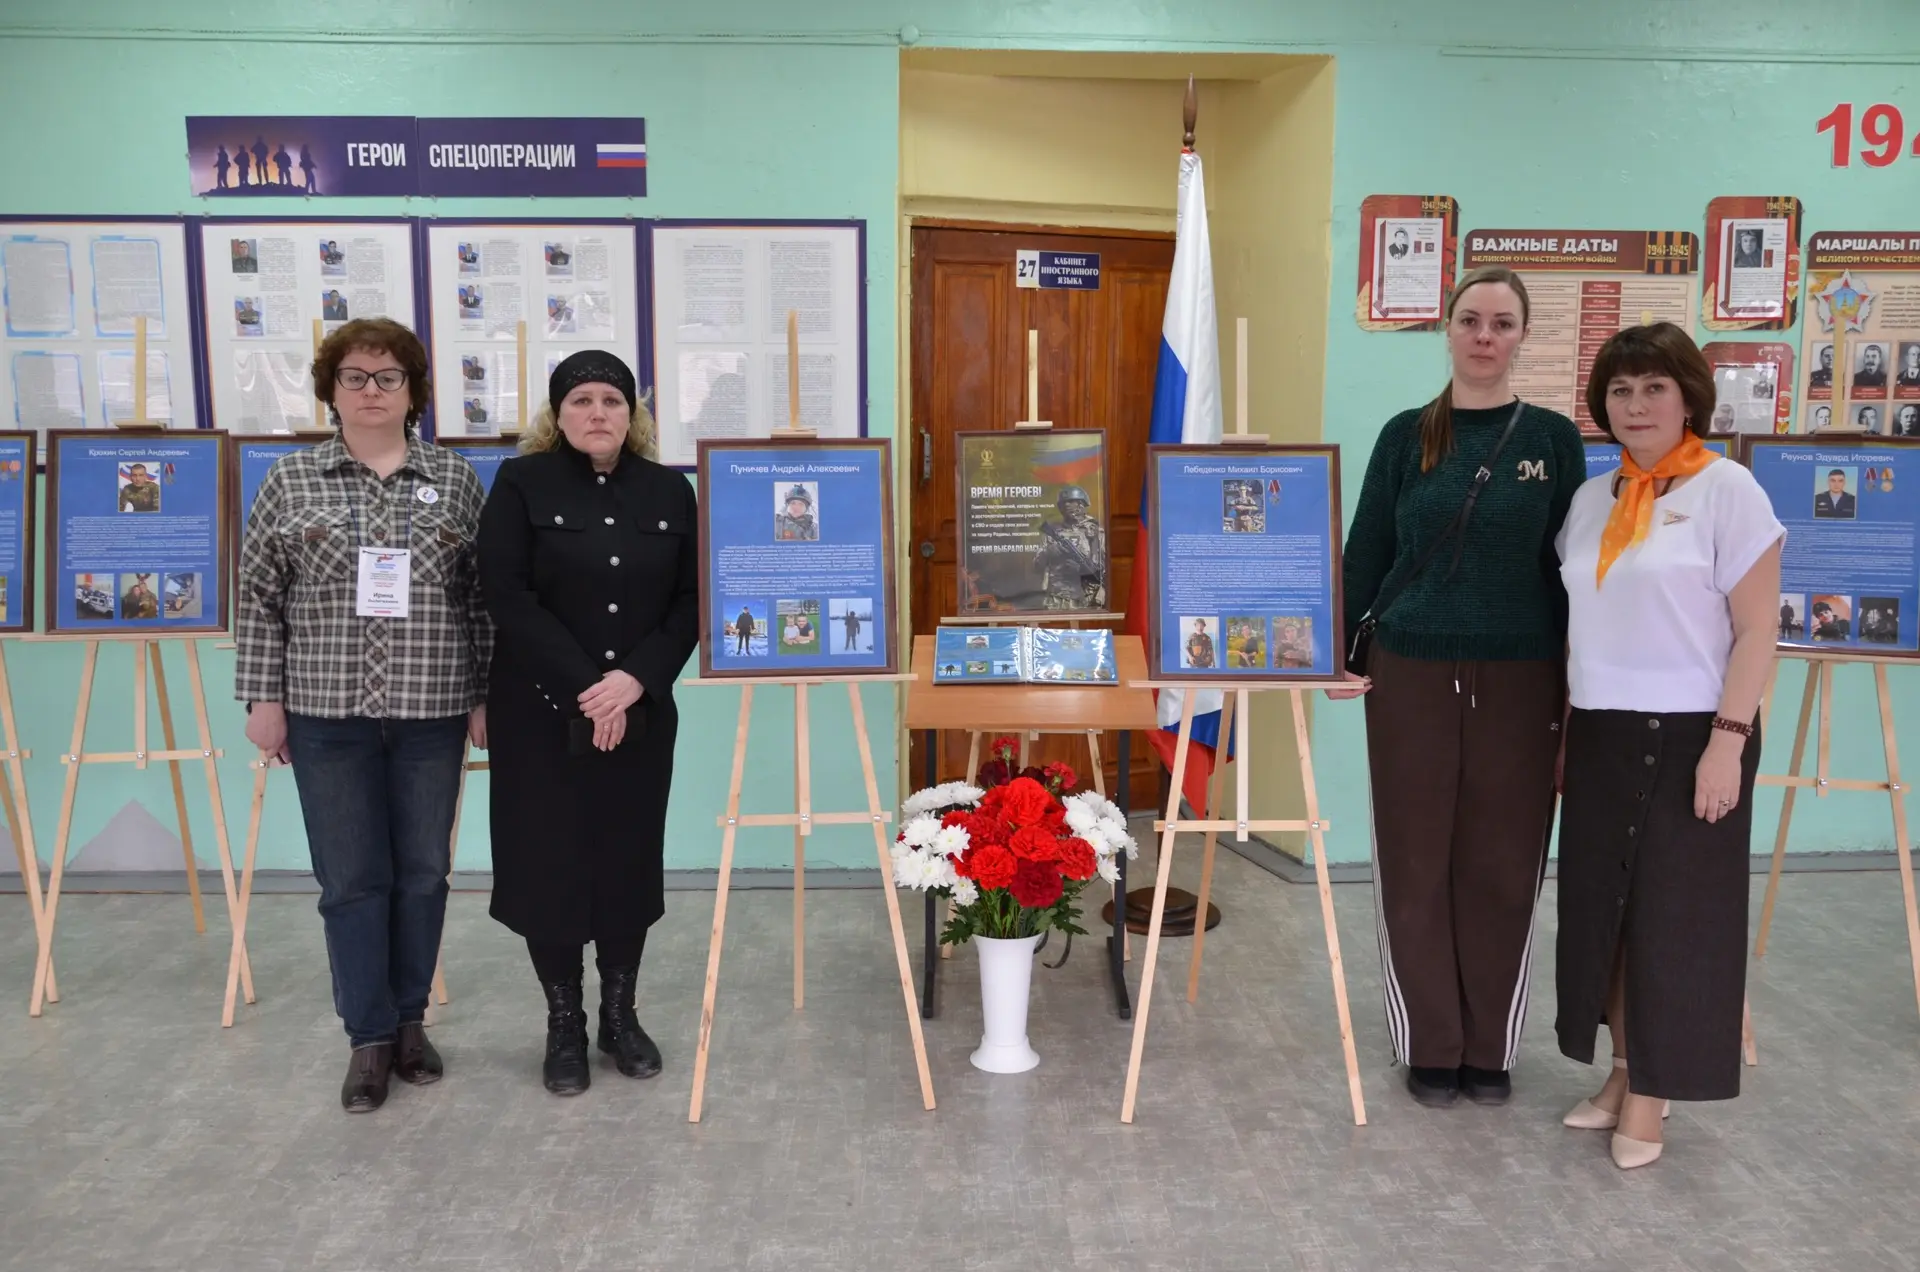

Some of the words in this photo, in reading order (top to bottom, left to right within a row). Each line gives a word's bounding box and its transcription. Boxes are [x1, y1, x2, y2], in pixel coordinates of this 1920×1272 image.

[1816, 102, 1920, 168] 19
[347, 143, 406, 167] ГЕРОИ
[429, 144, 576, 170] СПЕЦОПЕРАЦИИ
[1472, 238, 1558, 252] ВАЖНЫЕ
[1562, 238, 1618, 254] ДАТЫ
[1647, 244, 1689, 256] 1941-1945
[1816, 239, 1905, 251] МАРШАЛЫ
[1054, 256, 1087, 266] КАБИНЕТ
[1585, 255, 1617, 264] ВОЙНЫ
[1018, 259, 1037, 278] 27
[1041, 266, 1099, 276] ИНОСТРАННОГО
[1057, 277, 1083, 285] ЯЗЫКА
[118, 448, 145, 457] Сергей
[149, 449, 190, 457] Андреевич
[1815, 452, 1849, 463] Эдуард
[1851, 453, 1894, 463] Игоревич
[1586, 455, 1610, 463] ирнов
[730, 464, 769, 475] Пуничев
[771, 464, 805, 475] Андрей
[807, 463, 860, 474] Алексеевич
[1183, 465, 1226, 474] Лебеденко
[1228, 465, 1259, 474] Михаил
[1260, 465, 1303, 474] Борисович
[971, 486, 1002, 499] ВРЕМЯ
[1004, 486, 1042, 498] ГЕРОЕВ!
[971, 545, 992, 554] ВРЕМЯ
